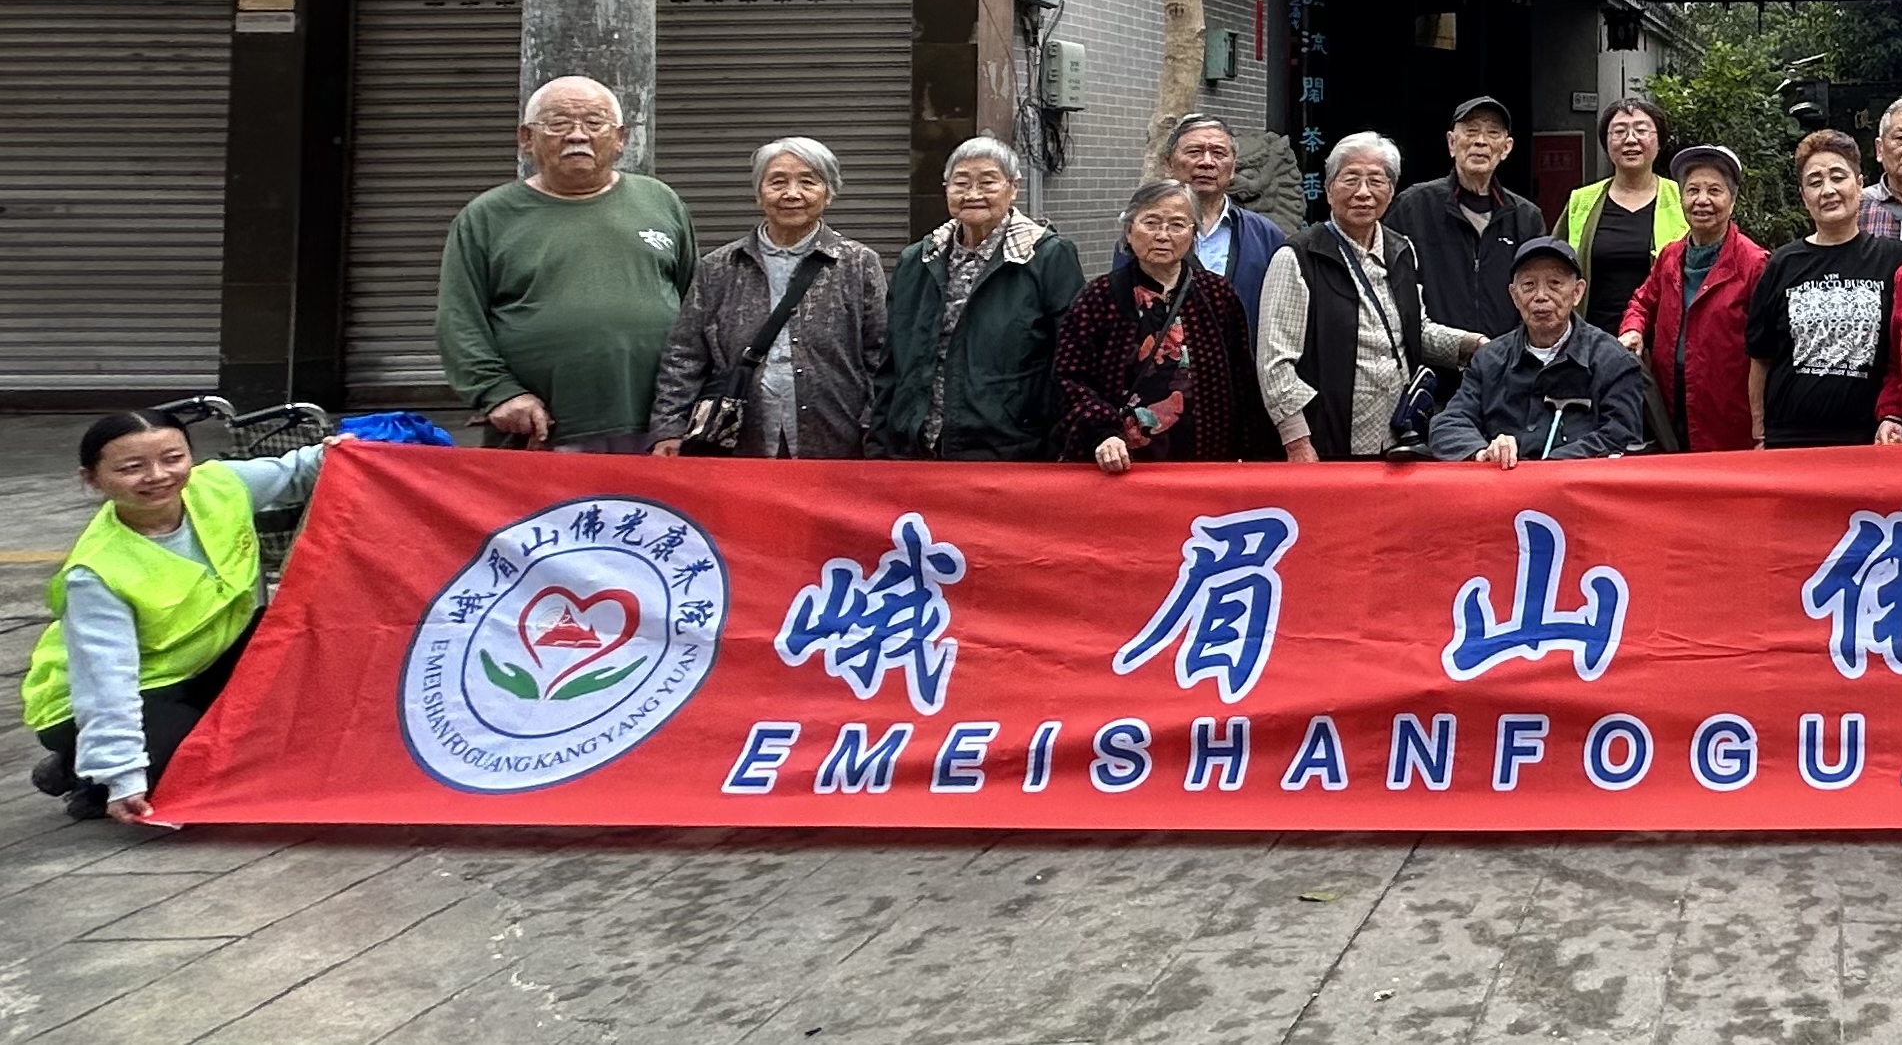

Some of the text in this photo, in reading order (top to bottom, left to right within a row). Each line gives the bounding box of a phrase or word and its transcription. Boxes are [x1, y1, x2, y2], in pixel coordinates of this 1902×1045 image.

[448, 504, 715, 636] 峨眉山佛光康养院
